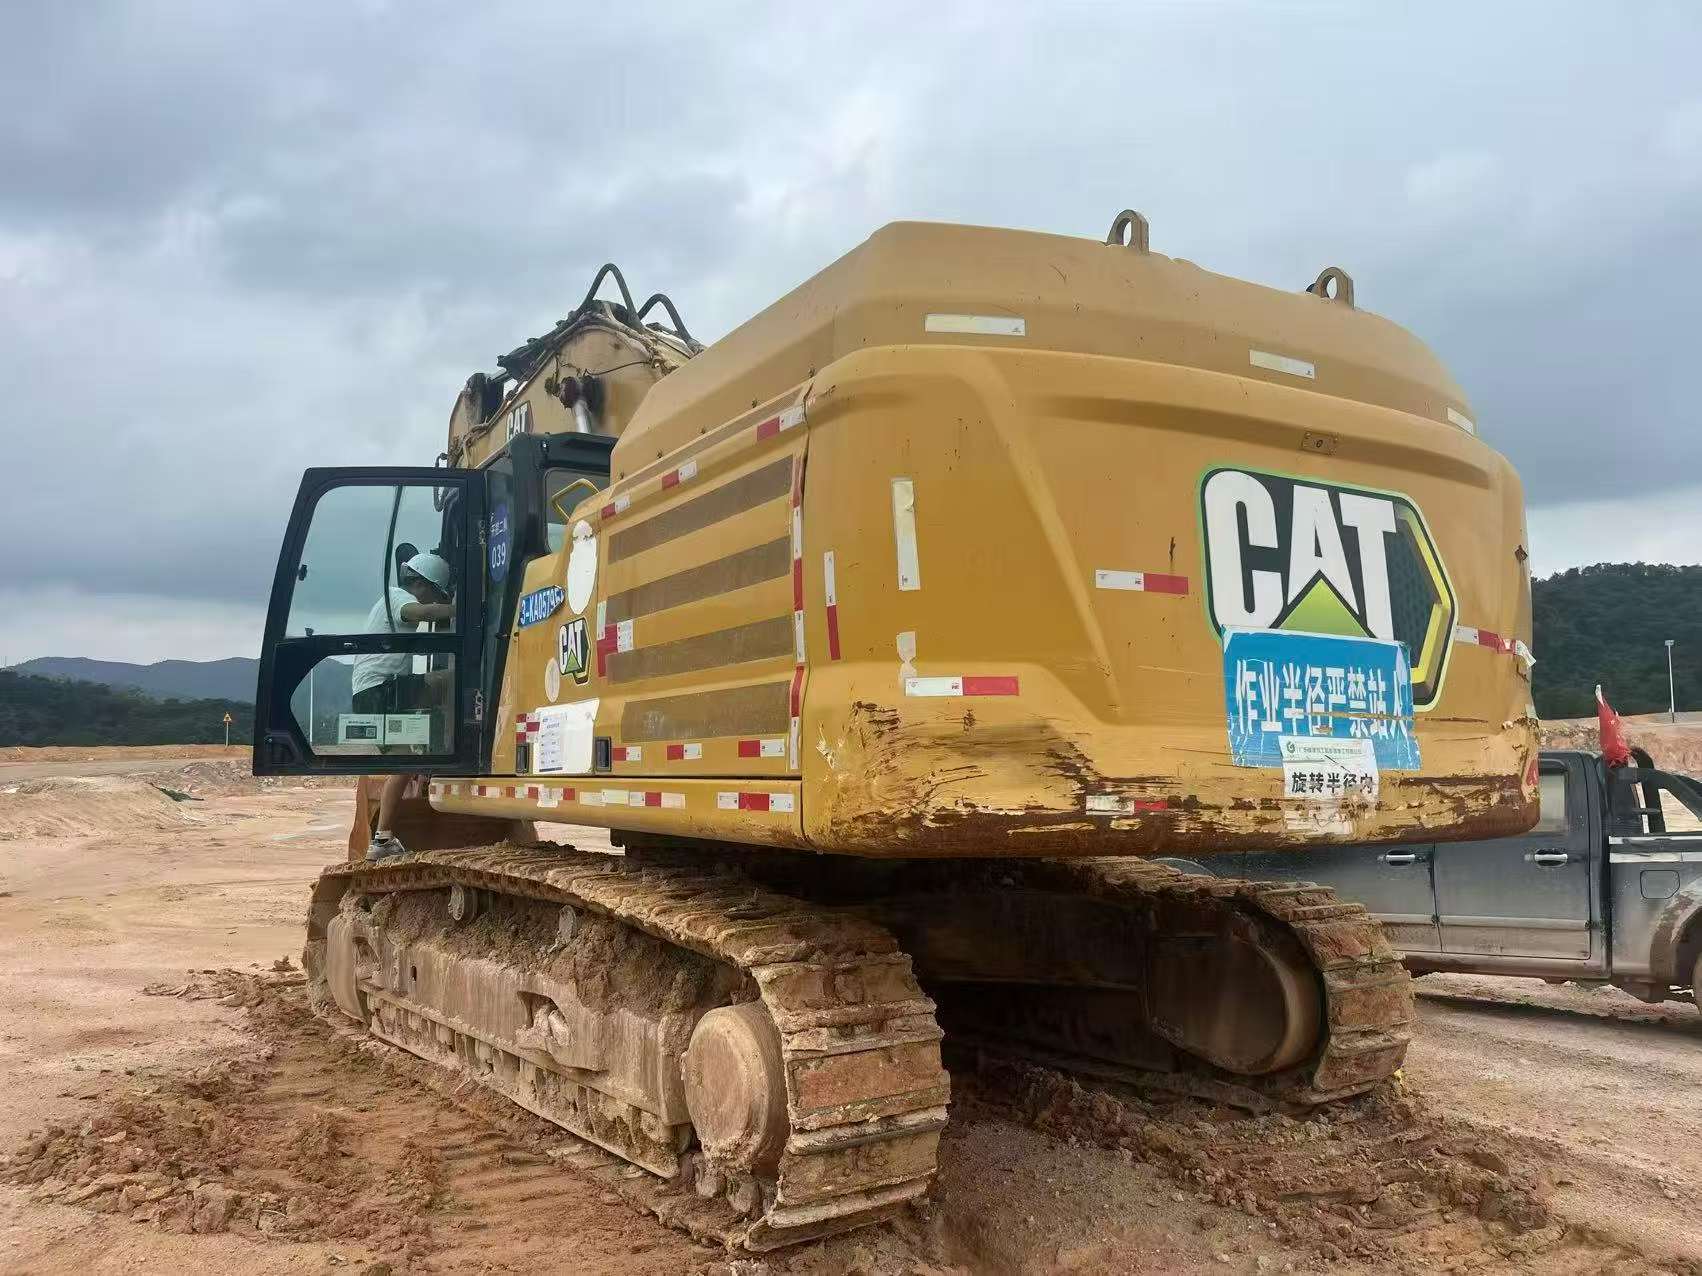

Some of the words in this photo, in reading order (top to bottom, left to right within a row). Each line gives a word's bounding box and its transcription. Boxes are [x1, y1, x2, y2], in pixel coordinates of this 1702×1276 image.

[507, 403, 528, 441] CAT
[491, 541, 506, 569] 039
[1204, 470, 1397, 639] CAT
[559, 619, 583, 674] CAT
[1235, 658, 1409, 740] 作业半径严禁站人
